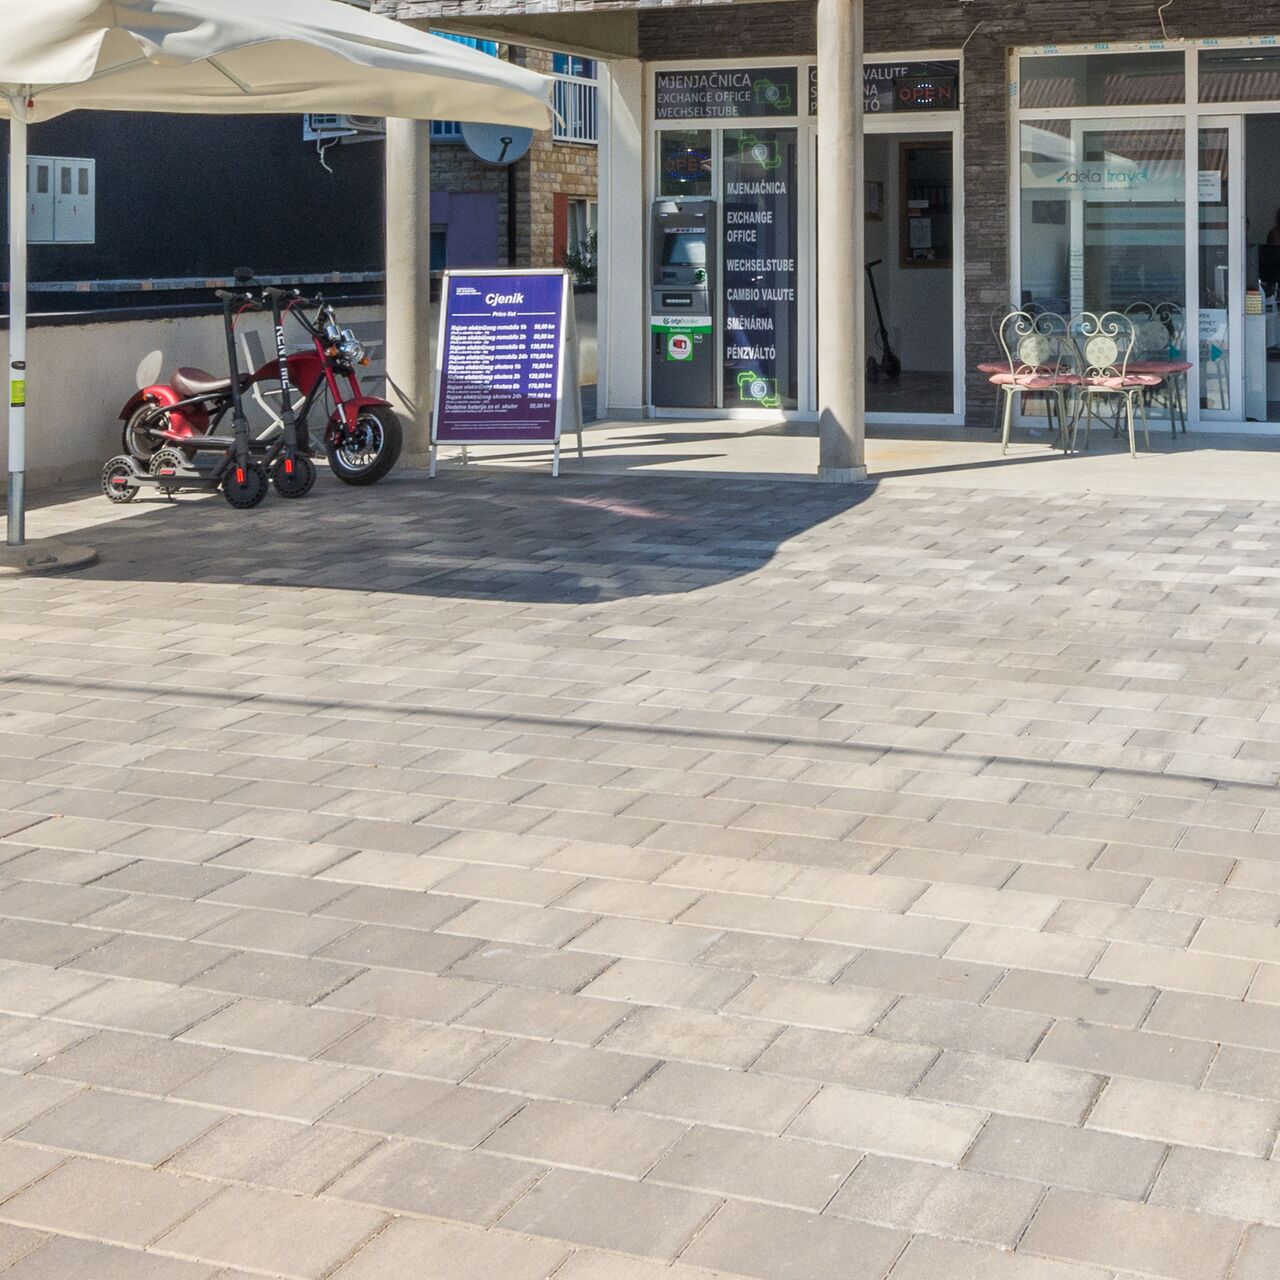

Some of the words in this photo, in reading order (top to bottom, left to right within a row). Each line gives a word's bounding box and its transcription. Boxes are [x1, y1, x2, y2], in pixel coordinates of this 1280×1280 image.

[657, 72, 751, 89] MJENJAČNICA
[657, 92, 713, 104] EXCHANGE
[715, 91, 751, 102] OFFICE
[900, 87, 951, 101] OPEN
[657, 106, 738, 118] WECHSELSTUBE
[1056, 169, 1101, 183] Adela
[1107, 164, 1149, 183] travel
[727, 179, 787, 195] MJENJAČNICA
[727, 211, 773, 224] EXCHANGE
[727, 229, 757, 242] OFFICE
[727, 259, 794, 271] WECHSELSTUBE
[485, 293, 524, 307] Cjenik
[727, 289, 760, 301] CAMBIO
[761, 289, 794, 301] VALUTE
[727, 344, 776, 360] PÉNZVÁLTÓ
